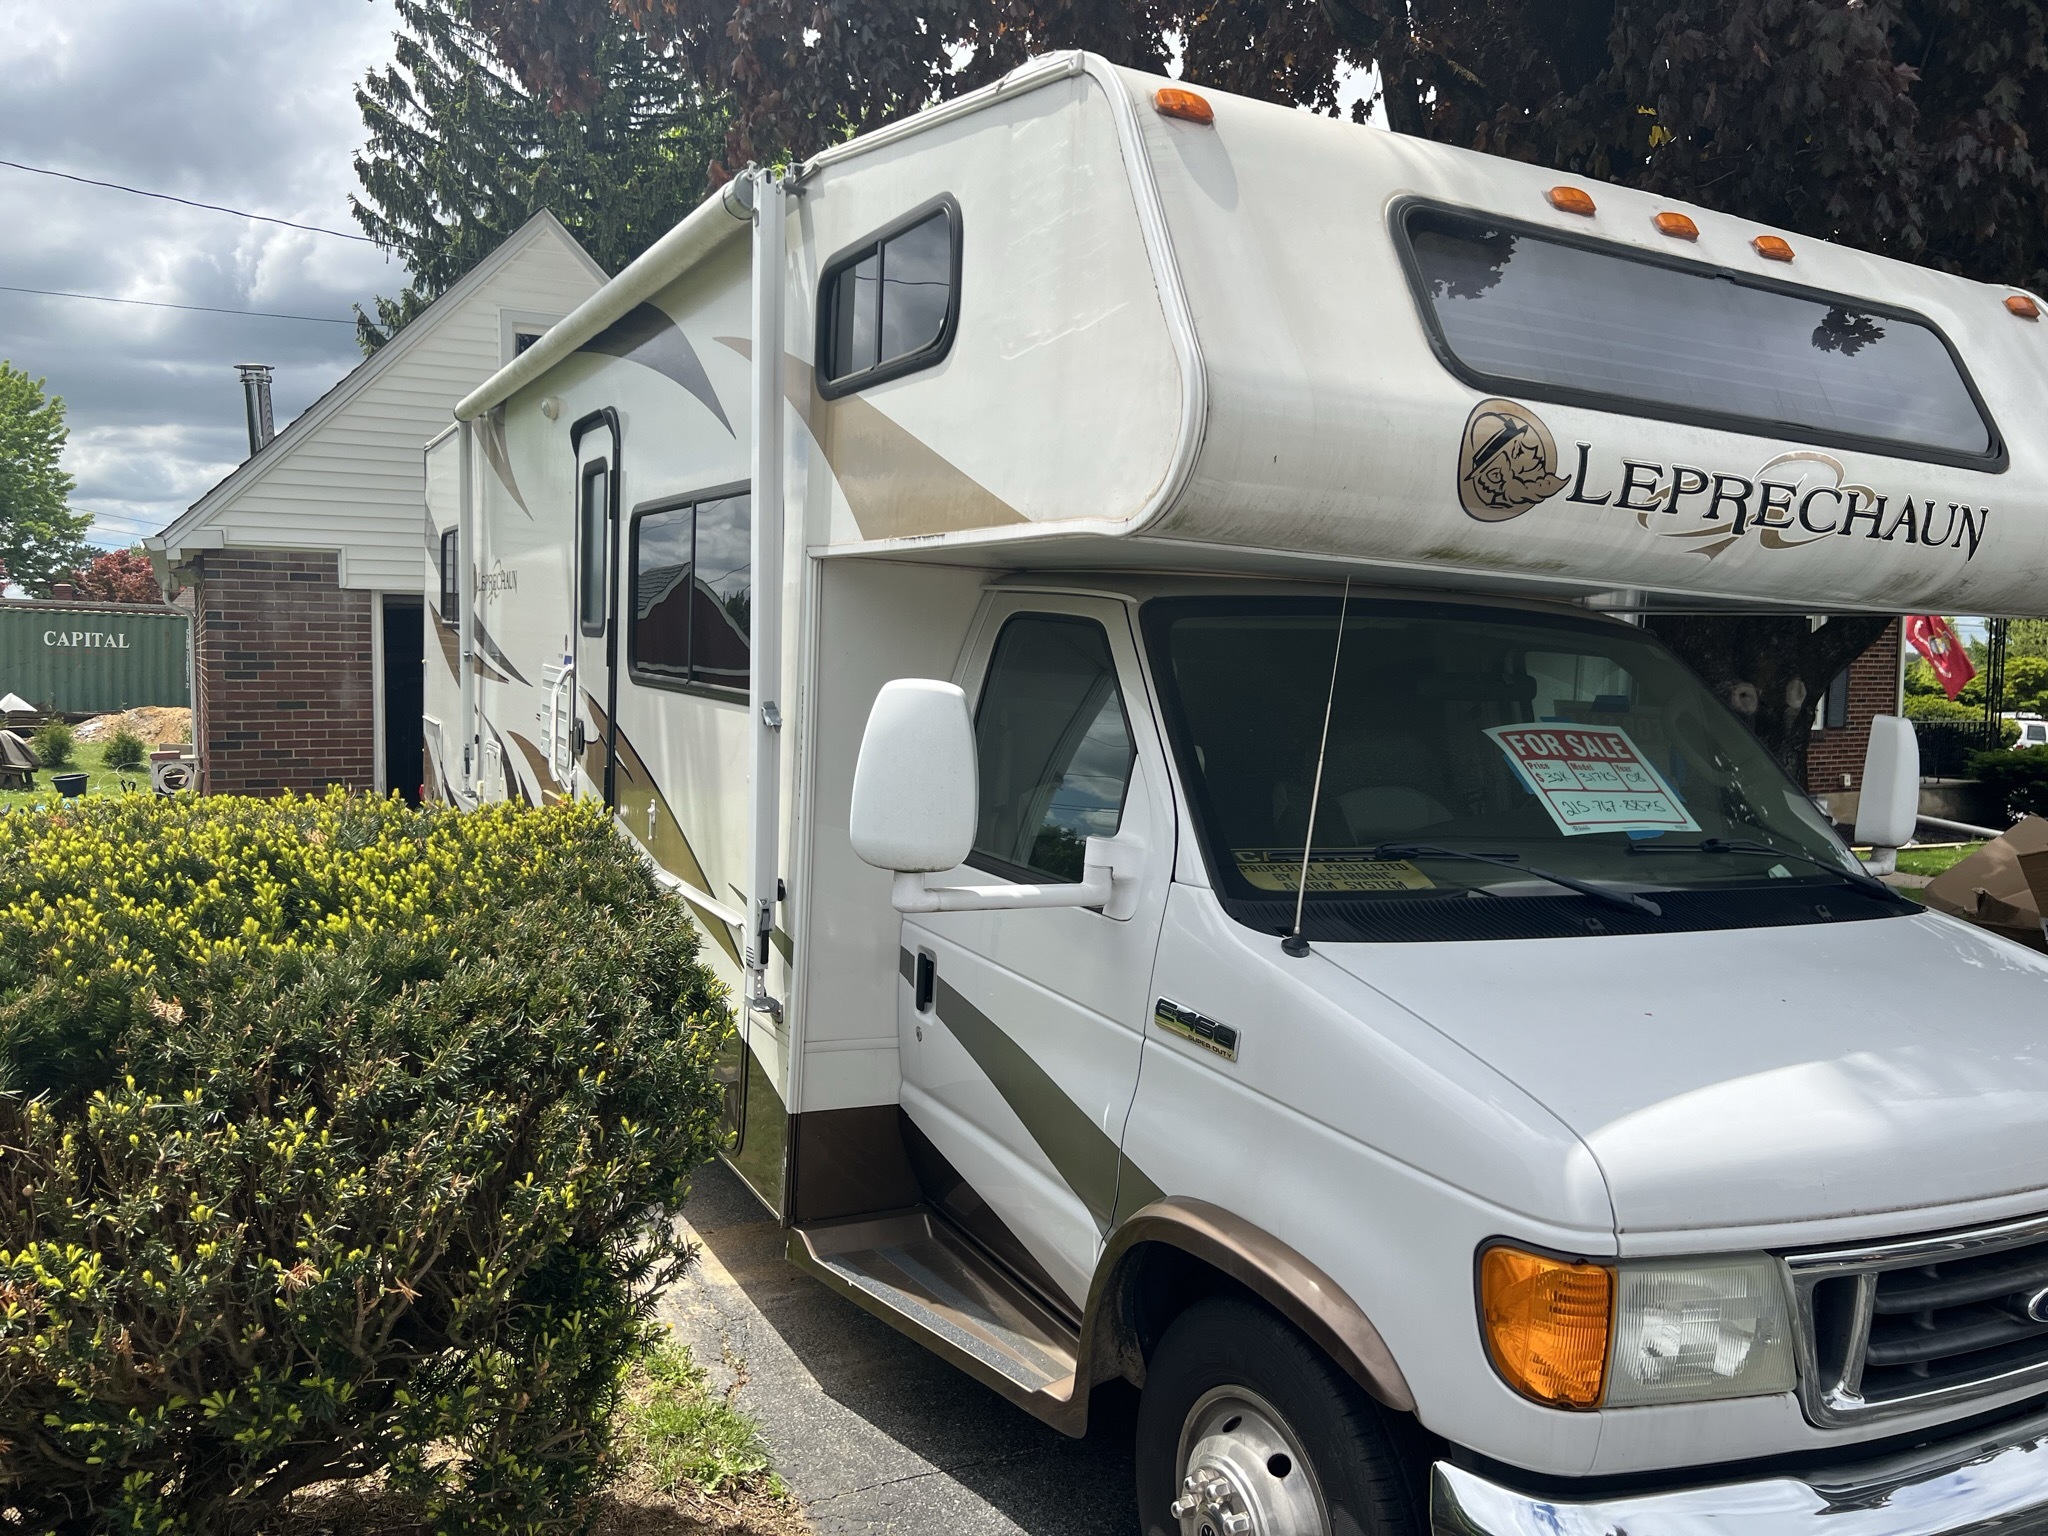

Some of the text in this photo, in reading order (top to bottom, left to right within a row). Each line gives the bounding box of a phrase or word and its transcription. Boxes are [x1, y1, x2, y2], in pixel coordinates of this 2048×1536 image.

[1565, 440, 1990, 562] LEPRECHAUN
[43, 630, 130, 649] CAPITAL
[1506, 733, 1631, 759] FOR SALE
[1526, 761, 1550, 770] Price
[1569, 763, 1594, 771] Model
[1625, 772, 1646, 783] 08
[1240, 862, 1409, 873] PROPERTY PROTECTED
[1273, 872, 1396, 882] BY ELECTRONIC
[1342, 880, 1408, 890] SYSTEM
[1187, 1034, 1233, 1059] SUPER DUTY
